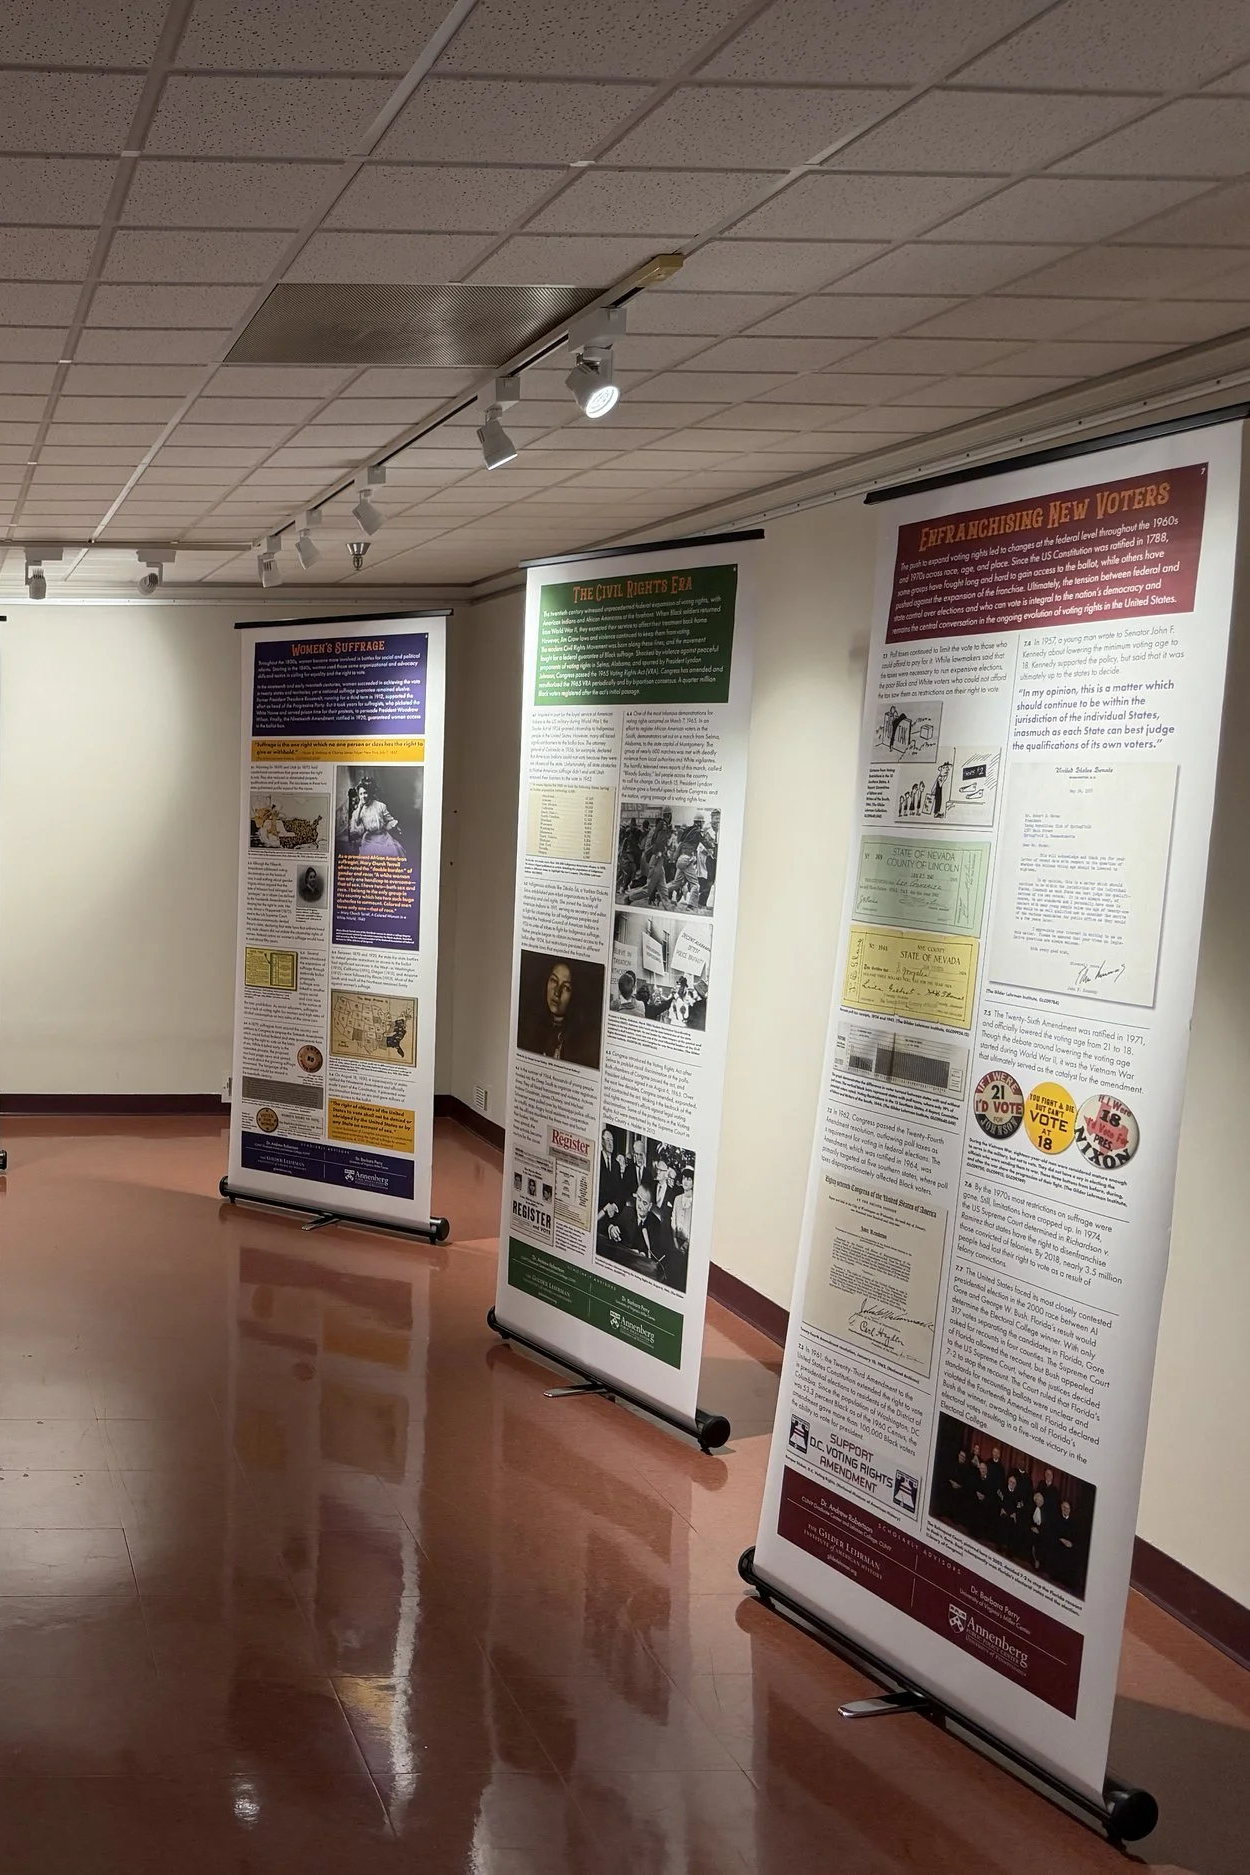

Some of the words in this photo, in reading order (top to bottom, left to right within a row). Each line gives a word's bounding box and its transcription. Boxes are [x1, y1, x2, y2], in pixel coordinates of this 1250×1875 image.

[918, 506, 1043, 552] ENFRANCHISING
[1047, 498, 1089, 530] NEW
[1095, 481, 1171, 520] VOTERS
[572, 586, 594, 604] THE
[595, 583, 623, 602] CIVIL
[626, 579, 668, 599] RIGHTS
[670, 576, 693, 595] ERA
[334, 639, 386, 655] SUFFRAGE
[1018, 688, 1030, 697] “In
[1031, 689, 1044, 698] my
[1045, 685, 1078, 698] opinion,
[1080, 684, 1094, 693] this
[1096, 683, 1103, 693] is
[1112, 683, 1143, 691] matter
[1145, 679, 1174, 690] which
[1016, 700, 1042, 710] should
[1043, 699, 1077, 709] continue
[1089, 697, 1100, 707] be
[1102, 696, 1129, 706] within
[1131, 695, 1145, 705] the
[1014, 713, 1057, 726] jurisdiction
[1058, 712, 1068, 722] of
[1069, 712, 1081, 721] the
[1083, 710, 1126, 721] individual
[1128, 710, 1159, 720] States,
[1013, 727, 1050, 737] inasmuch
[1062, 725, 1082, 735] each
[1083, 726, 1105, 735] State
[1124, 724, 1144, 734] best
[1145, 723, 1175, 736] judge
[1012, 741, 1024, 750] the
[1025, 740, 1078, 752] qualifications
[1080, 739, 1090, 749] of
[1090, 739, 1100, 749] its
[1124, 738, 1162, 748] voters.”
[893, 847, 912, 857] STATE
[913, 849, 924, 858] OF
[927, 850, 955, 861] NEVADA
[886, 857, 915, 868] COUNTY
[916, 861, 927, 869] OF
[927, 862, 959, 873] LINCOLN
[899, 951, 919, 960] STATE
[922, 953, 930, 962] OF
[933, 955, 961, 966] NEVADA
[977, 1082, 985, 1094] IF
[992, 1072, 1017, 1092] WERE
[991, 1085, 1005, 1100] 21
[975, 1100, 989, 1113] I'D
[993, 1101, 1023, 1115] VOTE
[1029, 1093, 1040, 1102] YOU
[1041, 1096, 1058, 1106] FIGHT
[1058, 1102, 1065, 1110] &
[1065, 1104, 1075, 1114] DIE
[1035, 1103, 1047, 1112] BUT
[1047, 1106, 1065, 1118] CAN'T
[1112, 1099, 1133, 1117] Were
[979, 1115, 1021, 1135] JOHNSON
[1029, 1110, 1069, 1133] VOTE
[1099, 1109, 1122, 1127] 18
[1041, 1128, 1052, 1136] AT
[1099, 1122, 1114, 1139] Vote
[551, 1128, 591, 1156] Register
[1037, 1135, 1053, 1151] 18
[1074, 1125, 1131, 1170] NIXON
[1093, 1133, 1113, 1152] PRES.
[355, 1171, 389, 1186] Annenberg
[512, 1200, 552, 1229] REGISTER
[532, 1224, 540, 1232] and
[620, 1316, 655, 1343] Annenberg
[830, 1433, 874, 1463] SUPPORT
[810, 1436, 825, 1452] D.C.
[826, 1444, 859, 1469] VOTING
[859, 1462, 894, 1489] RIGHTS
[819, 1455, 878, 1493] AMENDMENT
[828, 1503, 849, 1518] Andrew
[848, 1514, 874, 1534] Robertson
[818, 1527, 845, 1550] GILDER
[845, 1543, 881, 1570] LEHRMAN
[979, 1590, 1004, 1611] Barbara
[1004, 1605, 1021, 1622] Perry
[967, 1616, 1029, 1669] Annenberg
